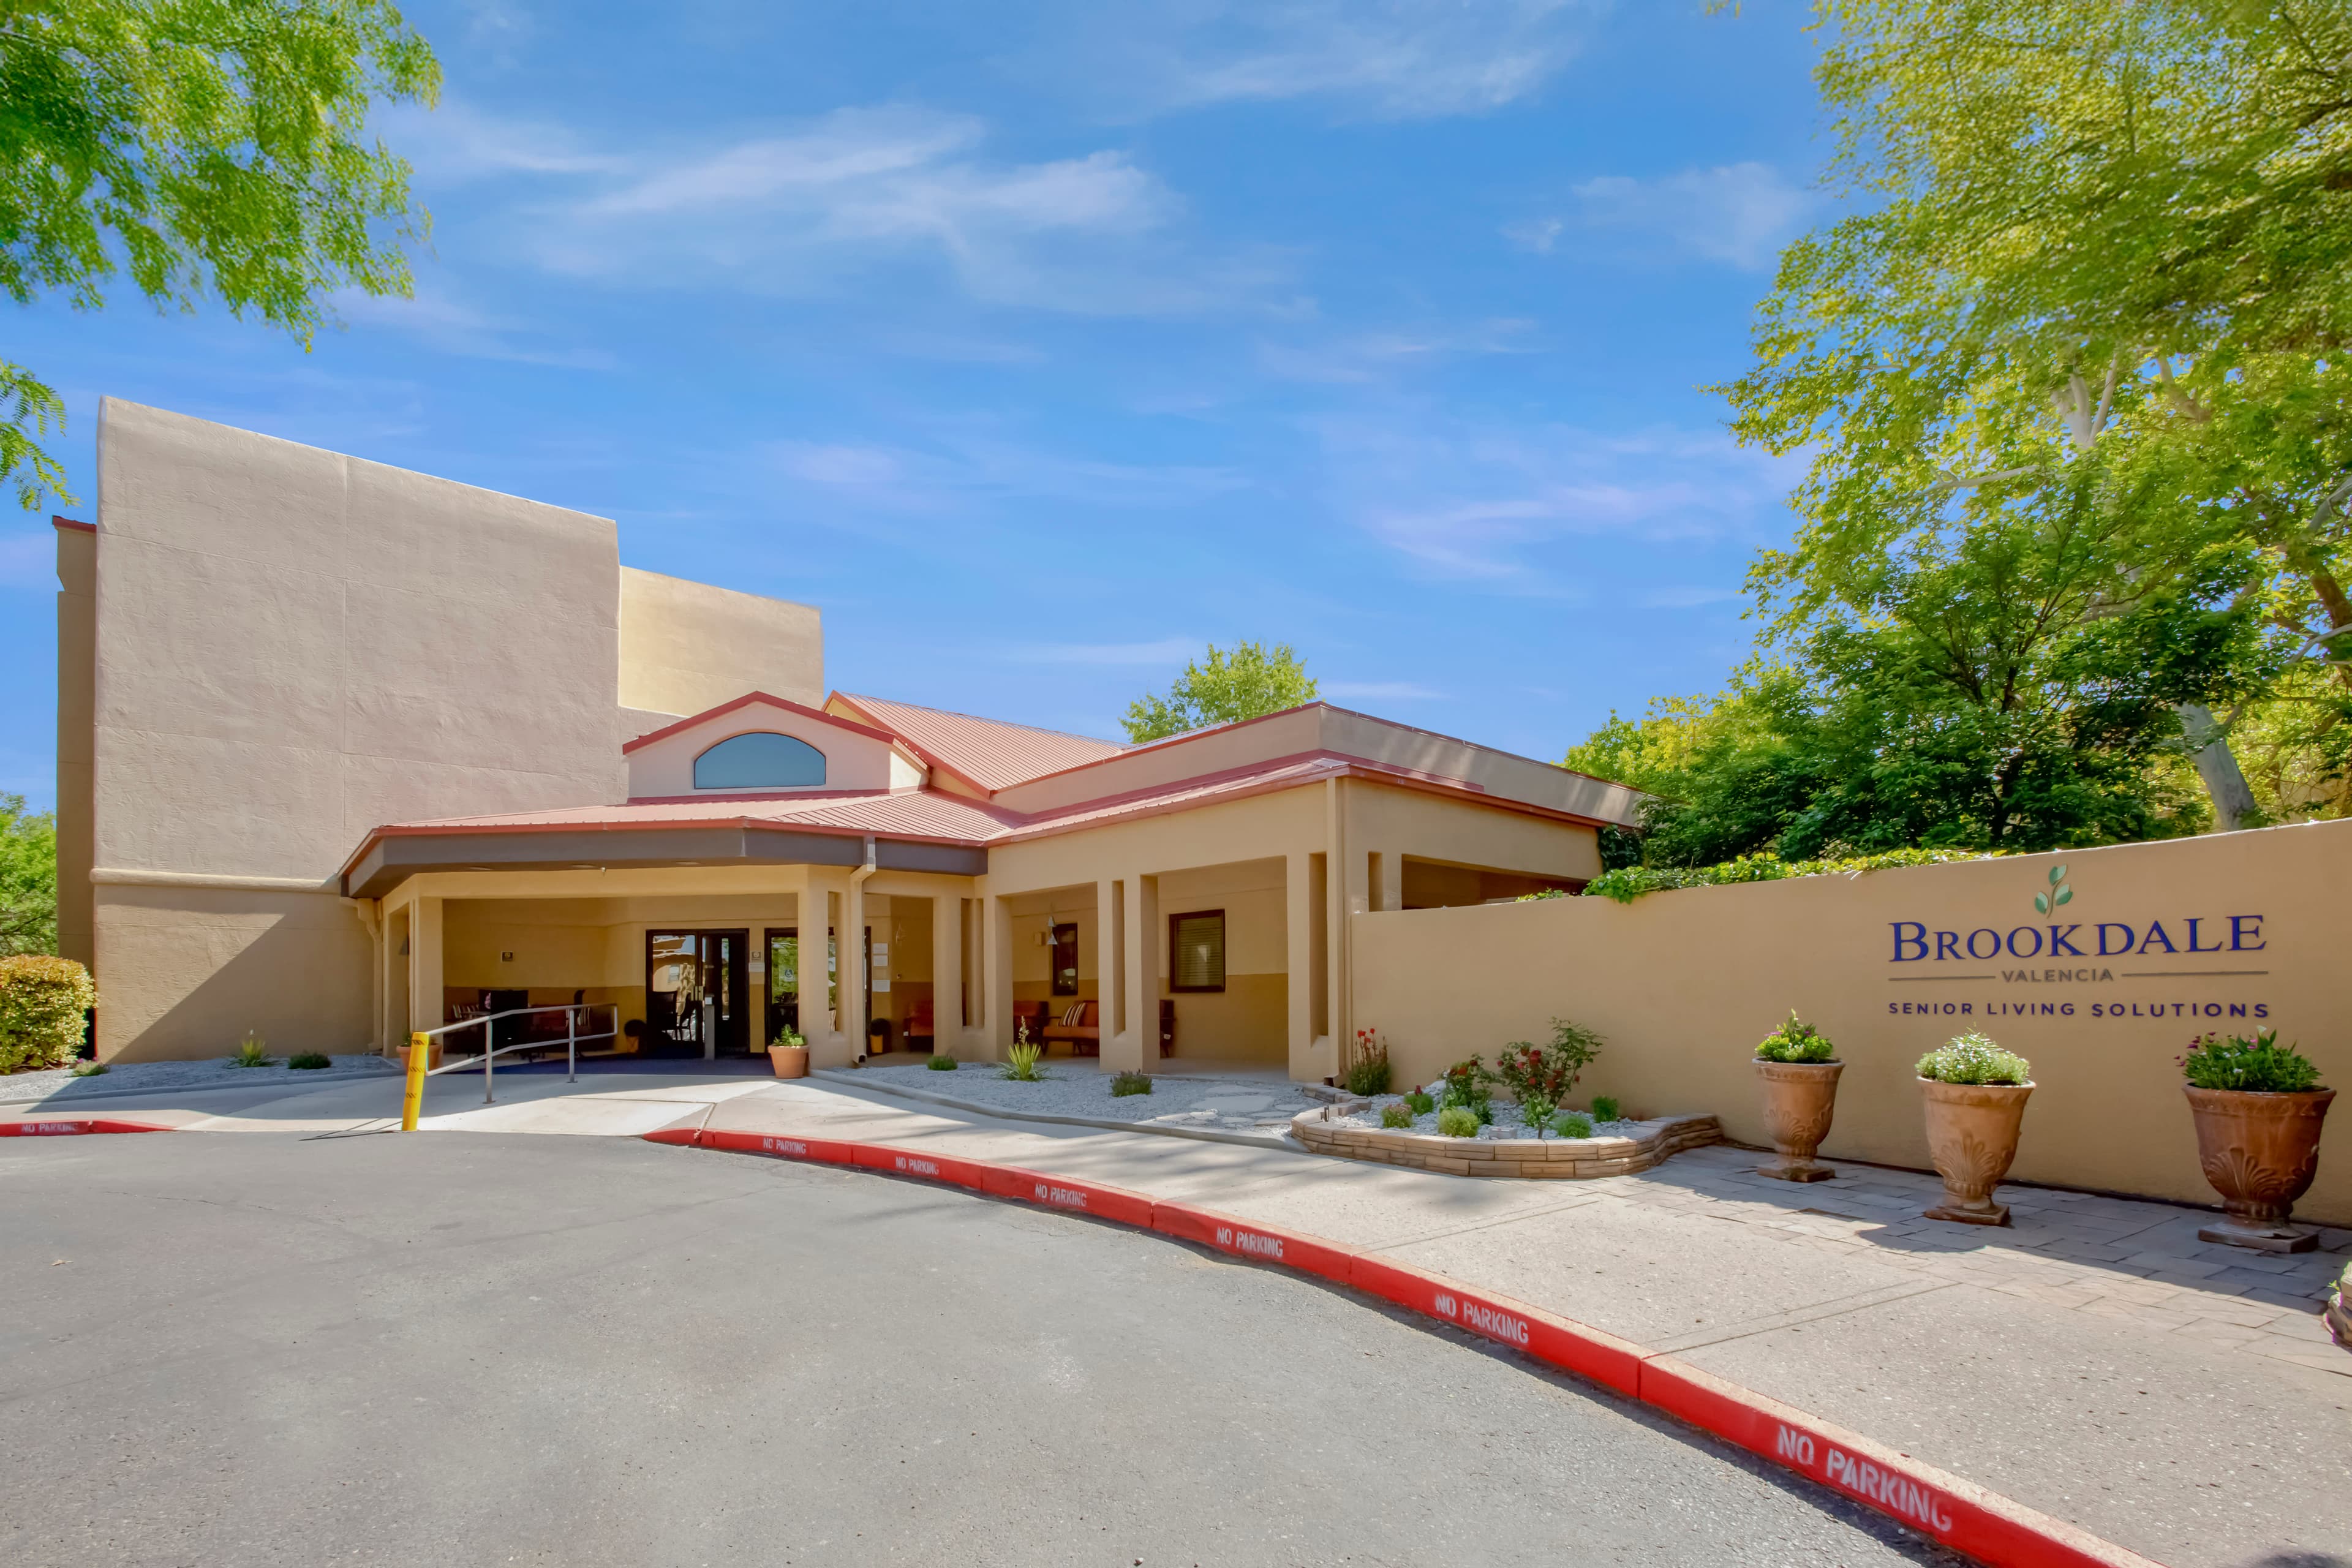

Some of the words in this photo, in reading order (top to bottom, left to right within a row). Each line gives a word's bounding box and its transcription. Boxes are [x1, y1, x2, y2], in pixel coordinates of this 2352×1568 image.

[1888, 914, 2267, 962] BROOKDALE
[2001, 968, 2114, 982] VALENCIA
[1888, 1003, 1972, 1015] SENIOR
[1987, 1003, 2075, 1016] LIVING
[2092, 1003, 2269, 1017] SOLUTIONS
[21, 1123, 35, 1133] NO
[39, 1122, 78, 1133] PARKING
[763, 1137, 773, 1149] NO
[776, 1139, 806, 1154] PARKING
[895, 1156, 906, 1169] NO
[908, 1158, 940, 1175] PARKING
[1035, 1183, 1047, 1199] NO
[1050, 1187, 1087, 1207] PARKING
[1216, 1226, 1232, 1245] NO
[1236, 1231, 1283, 1257] PARKING
[1435, 1294, 1457, 1317] NO
[1463, 1301, 1529, 1343] PARKING
[1777, 1425, 1814, 1465] NO
[1826, 1447, 1953, 1531] PARKING
